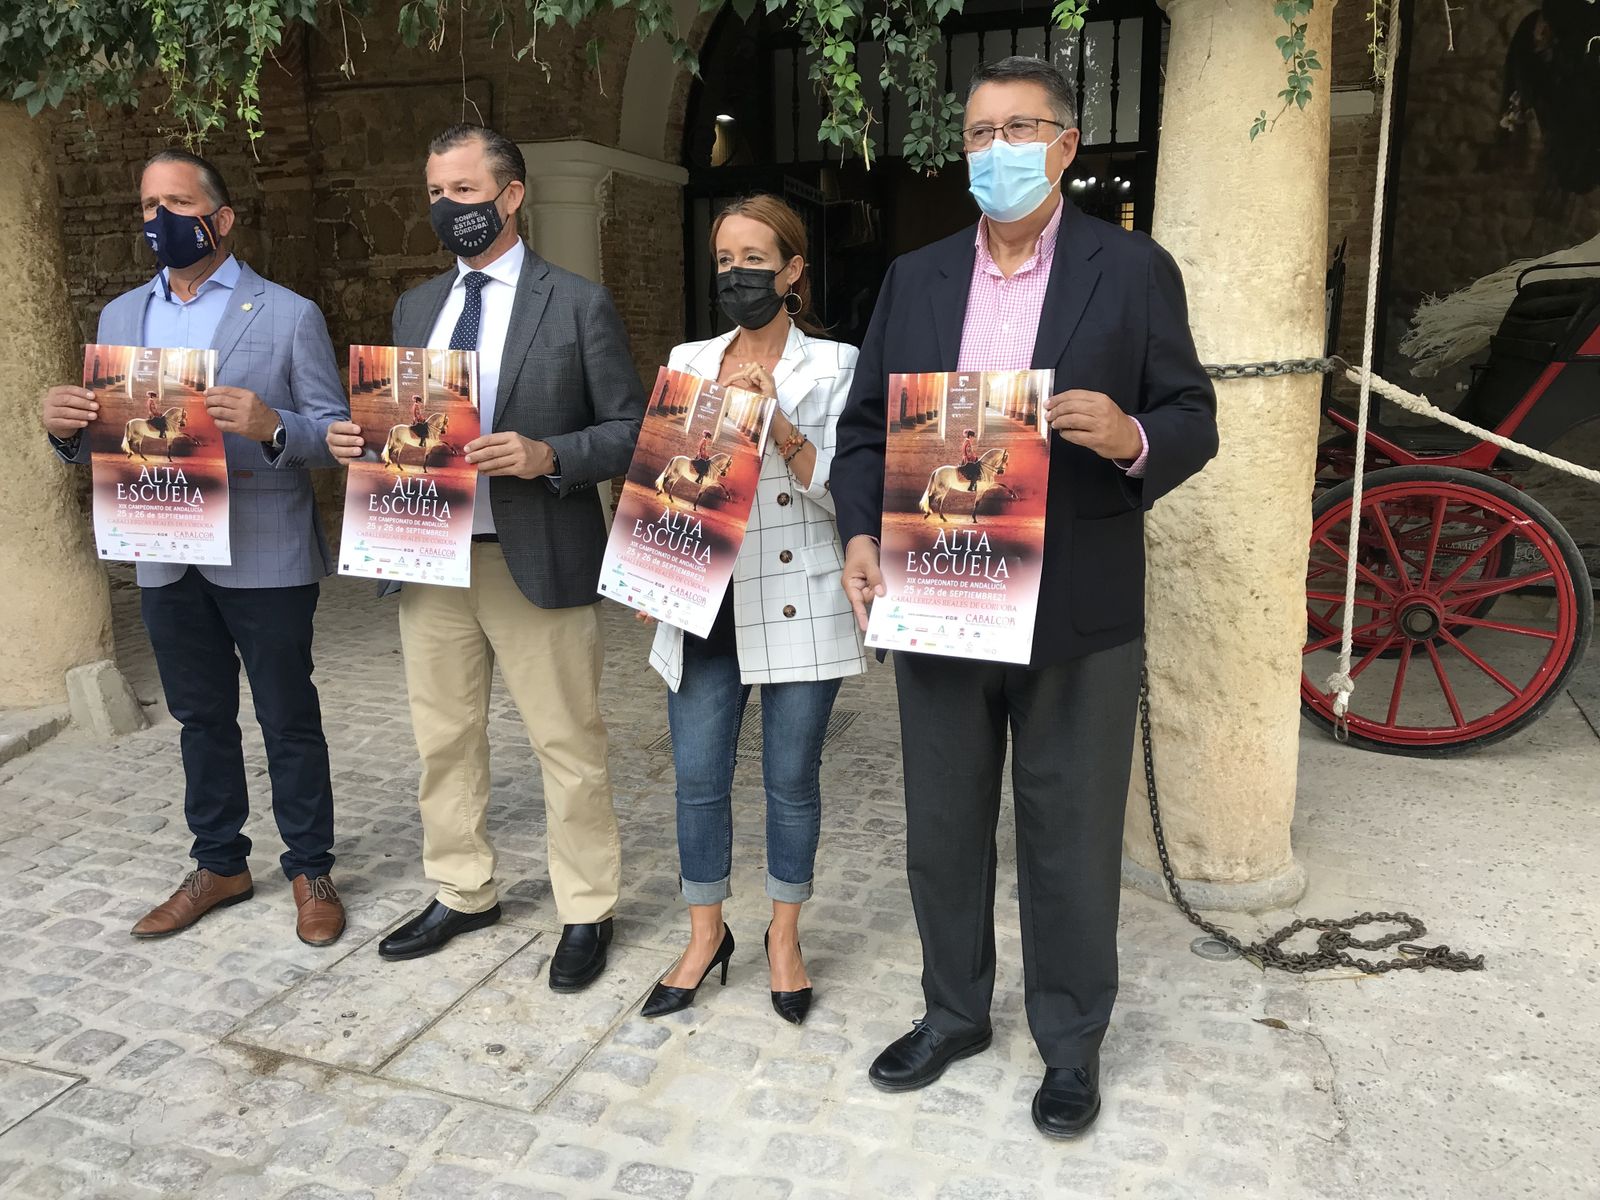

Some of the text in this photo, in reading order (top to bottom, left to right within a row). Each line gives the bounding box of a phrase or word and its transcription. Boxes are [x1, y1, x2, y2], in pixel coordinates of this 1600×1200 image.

[476, 215, 486, 223] EN
[138, 464, 188, 486] ALTA
[117, 482, 205, 507] ESCUELA
[391, 475, 439, 498] ALTA
[135, 510, 145, 518] 26
[367, 494, 451, 521] ESCUELA
[366, 522, 376, 530] 25
[383, 523, 394, 531] 26
[378, 516, 413, 525] CAMPEONATO
[658, 506, 703, 538] ALTA
[632, 519, 711, 565] ESCUELA
[933, 528, 992, 554] ALTA
[626, 546, 636, 556] 25
[641, 552, 651, 562] 26
[652, 556, 661, 565] de
[639, 543, 671, 560] CAMPEONATO
[906, 551, 1010, 583] ESCUELA
[903, 584, 915, 594] 25
[924, 586, 935, 595] 26
[937, 588, 947, 596] de
[917, 578, 959, 587] CAMPEONATO
[959, 580, 969, 588] DE
[969, 581, 1007, 590] ANDALUCÍA
[965, 613, 1016, 625] CABALCOR
